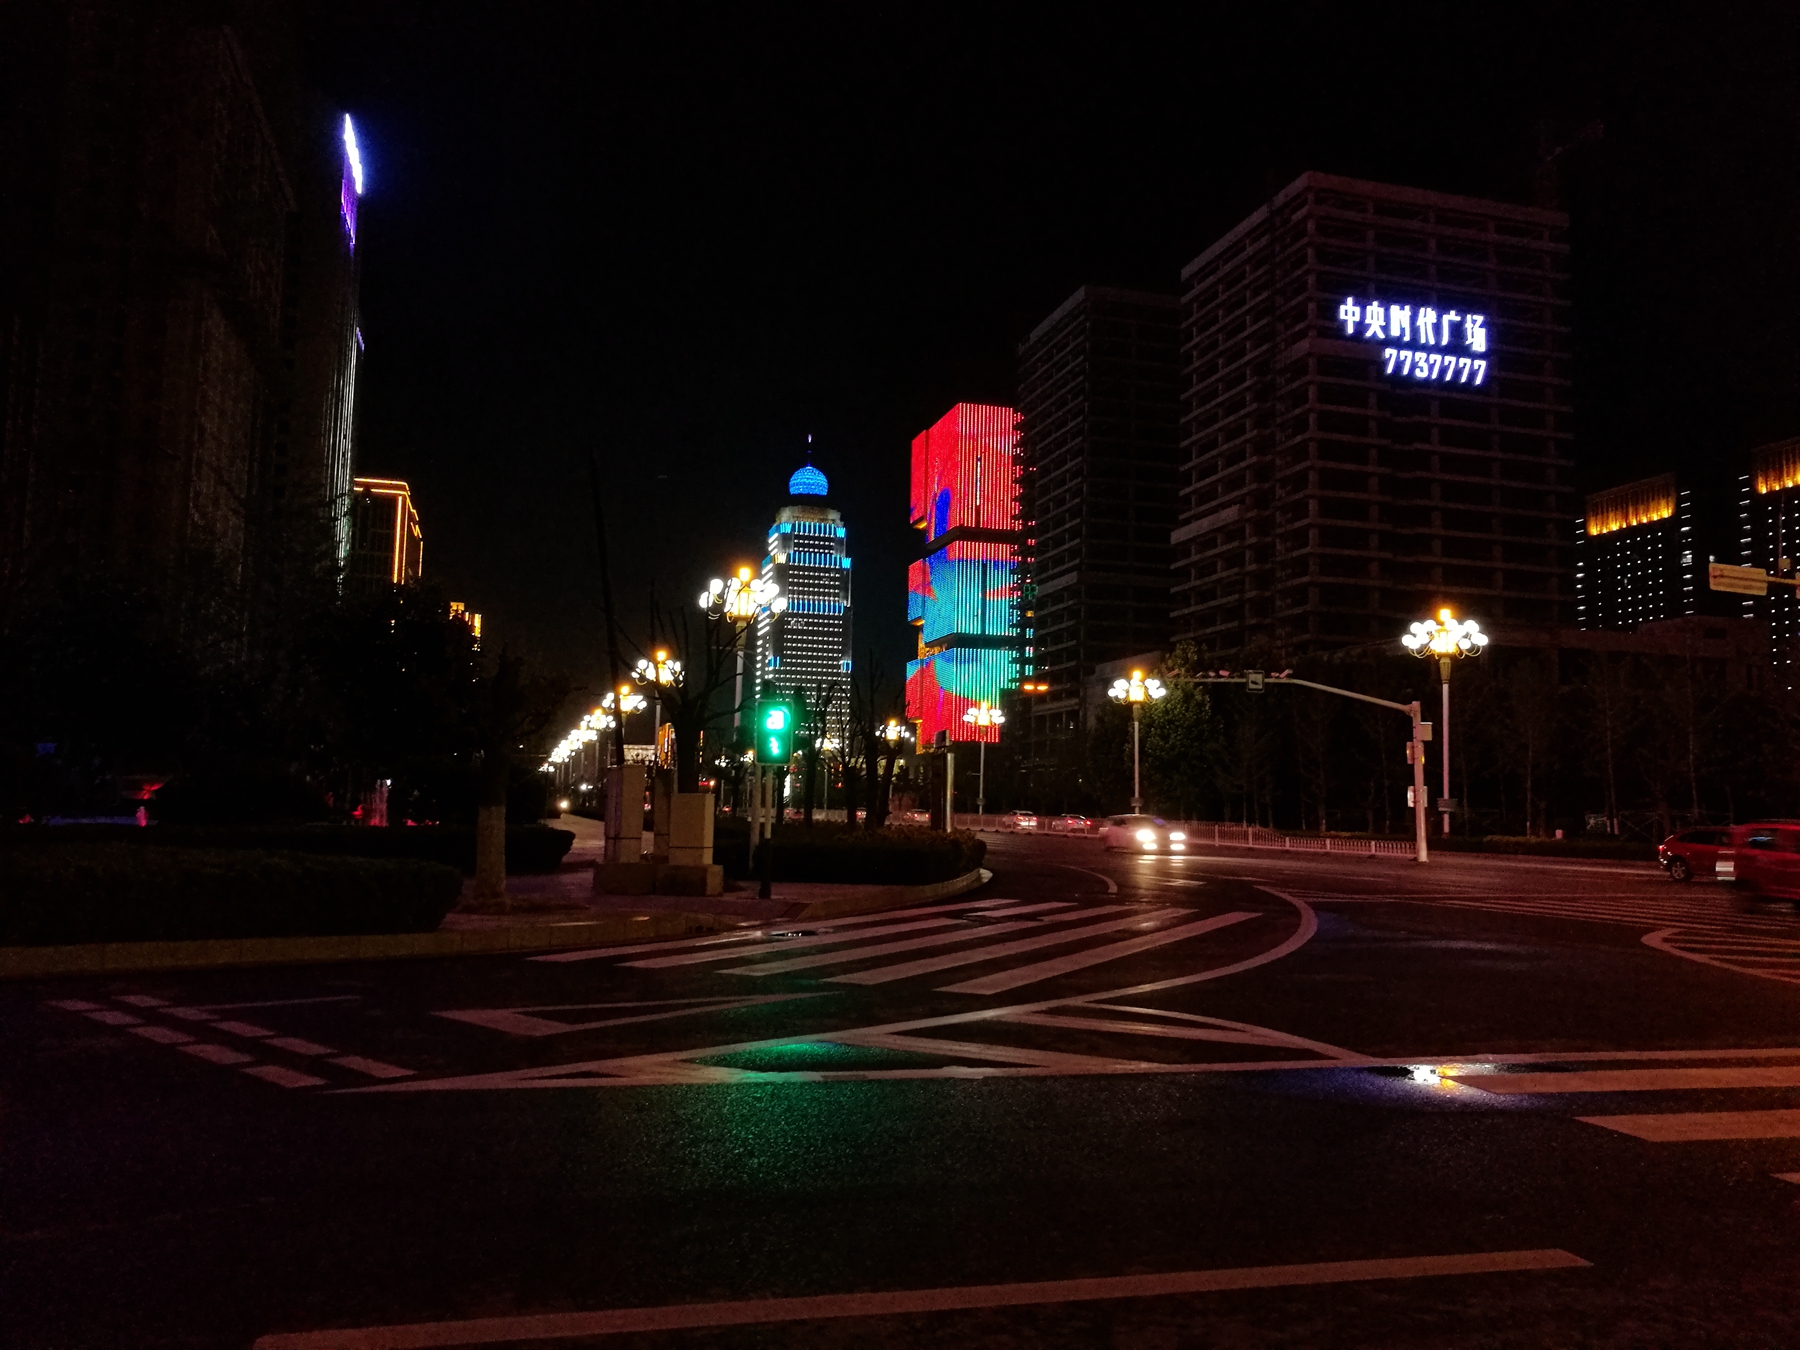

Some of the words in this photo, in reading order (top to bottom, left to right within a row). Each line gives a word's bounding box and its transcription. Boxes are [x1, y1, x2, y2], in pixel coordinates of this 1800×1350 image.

[1339, 297, 1487, 352] 中央时代广场
[1384, 348, 1487, 385] 7737777
